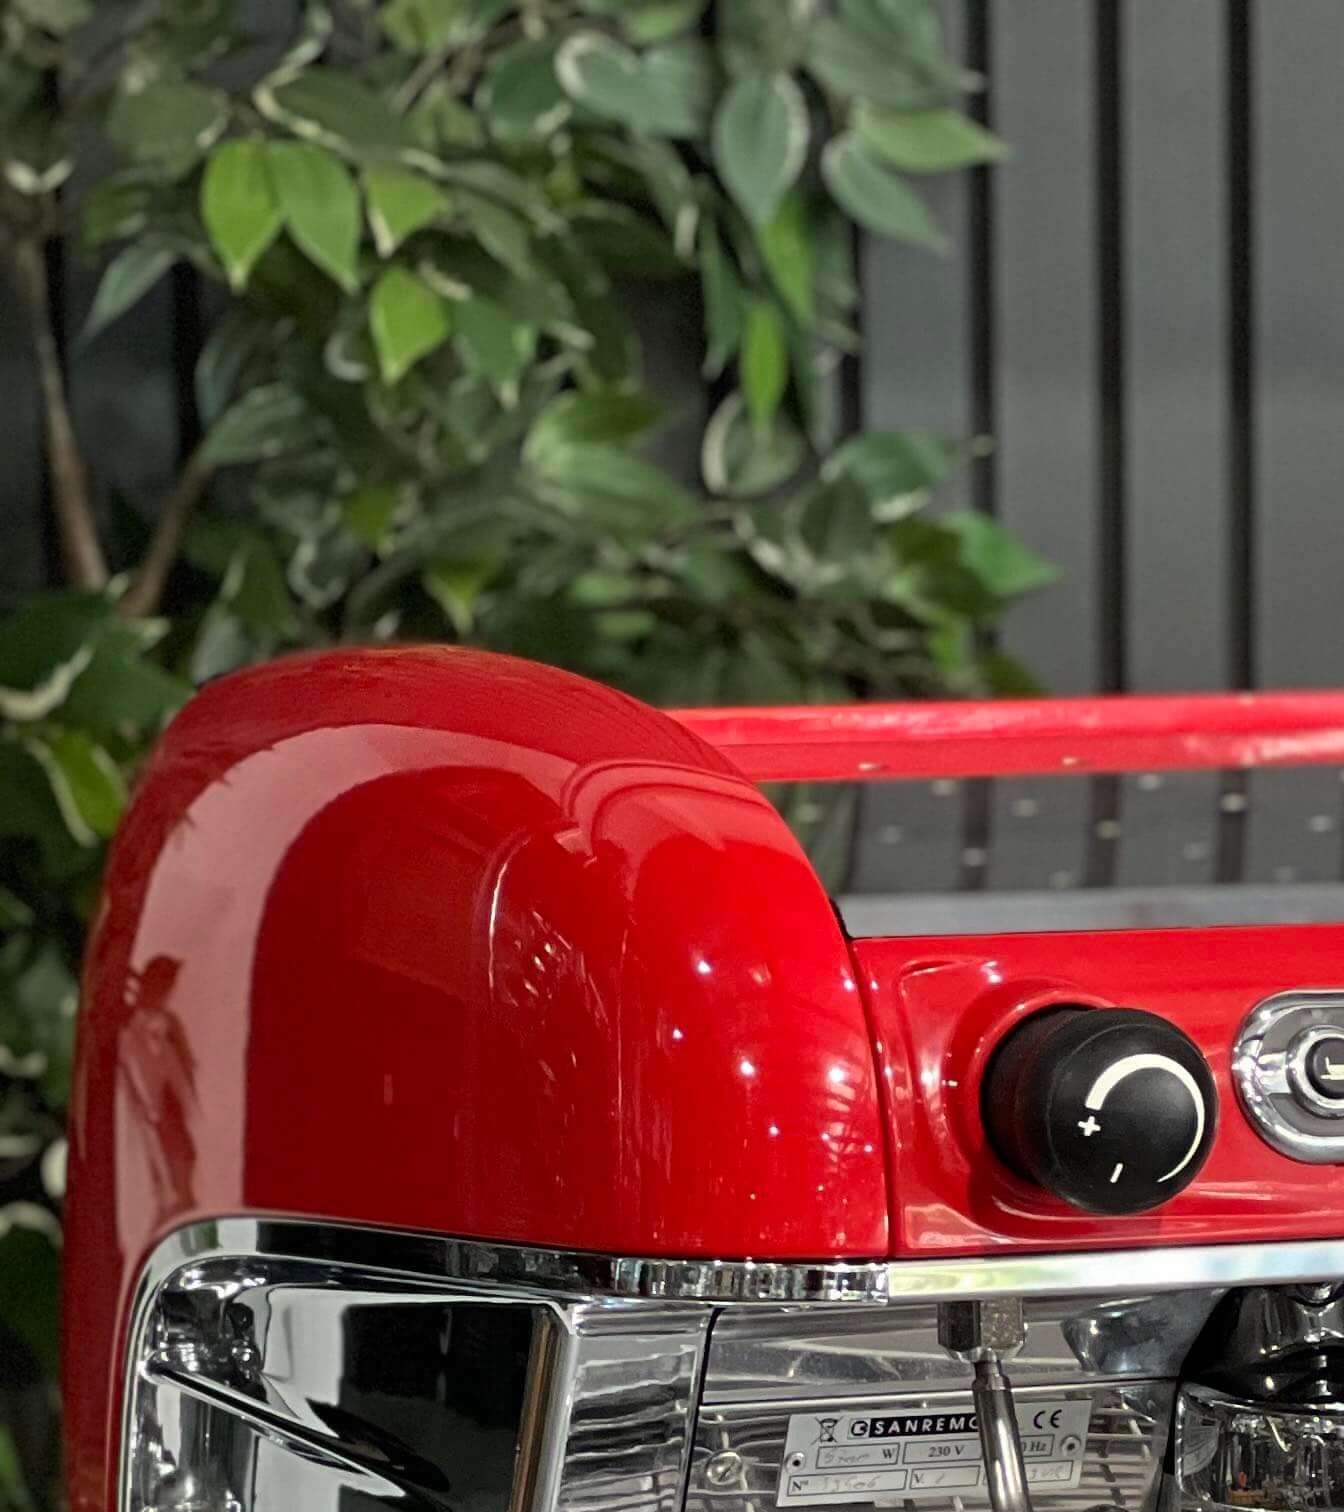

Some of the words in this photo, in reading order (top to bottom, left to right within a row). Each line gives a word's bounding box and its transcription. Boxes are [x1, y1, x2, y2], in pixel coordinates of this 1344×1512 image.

[1033, 1409, 1062, 1430] CE
[928, 1446, 951, 1458] 230
[955, 1445, 965, 1456] V
[1030, 1440, 1047, 1452] Hz
[882, 1447, 897, 1459] W
